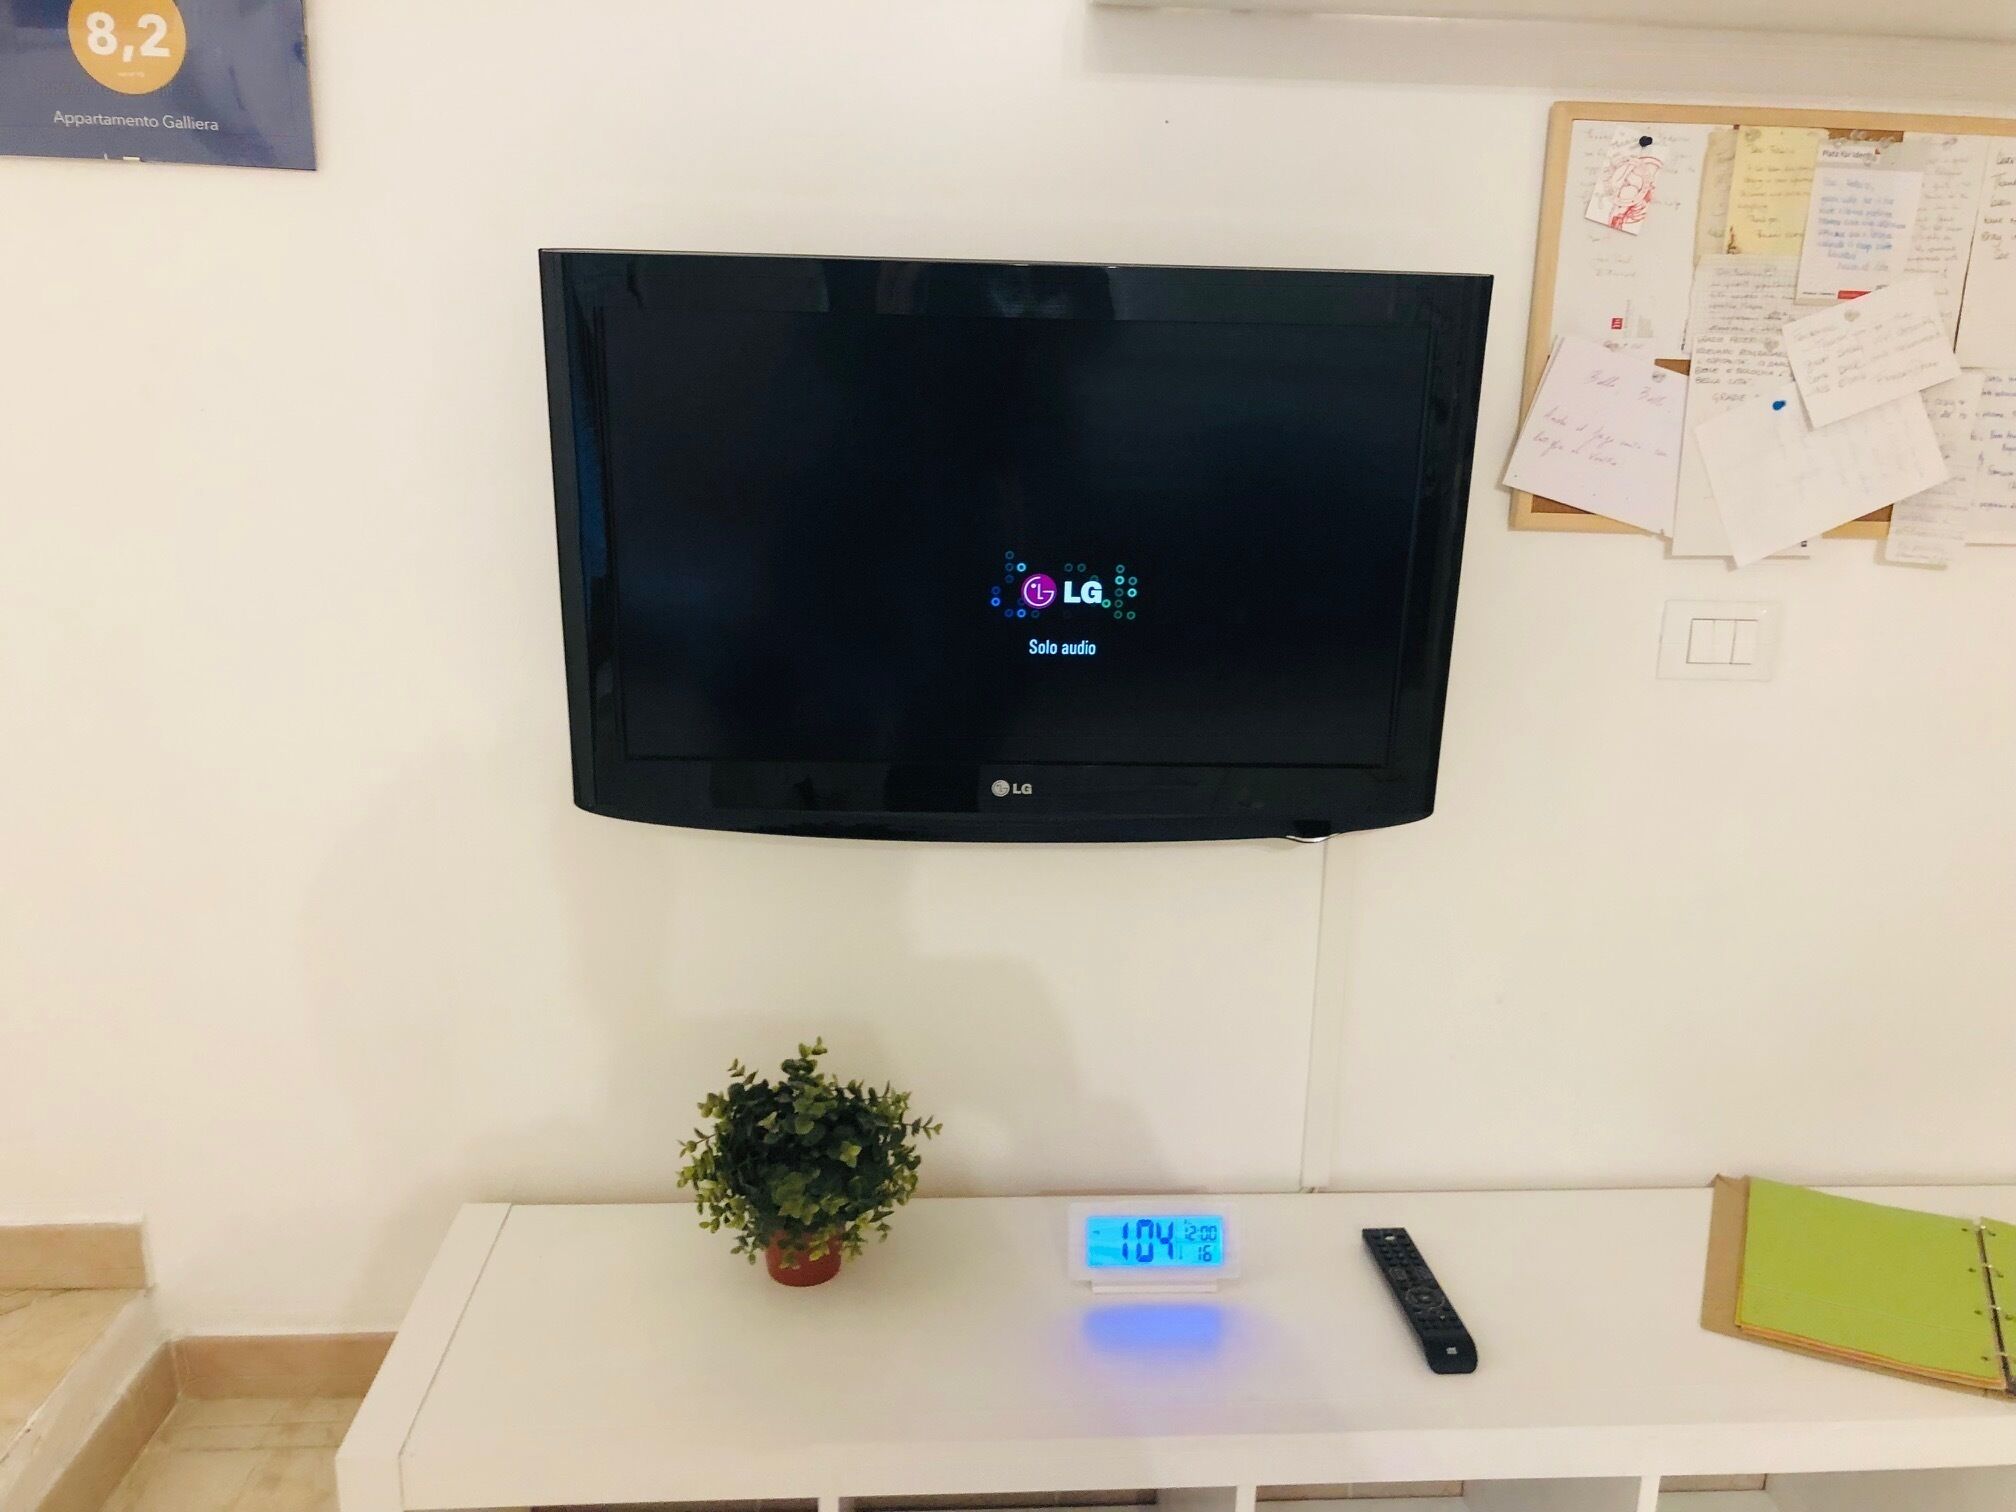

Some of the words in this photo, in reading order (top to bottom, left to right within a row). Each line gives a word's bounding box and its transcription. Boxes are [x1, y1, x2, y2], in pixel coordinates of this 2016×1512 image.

[86, 11, 171, 63] 8,2
[53, 110, 159, 128] Appartamento
[162, 115, 219, 131] Galliera
[1063, 581, 1103, 604] LG
[1029, 639, 1057, 655] Solo
[1061, 639, 1096, 655] audio
[1012, 783, 1032, 794] LG
[1198, 1245, 1213, 1262] 16
